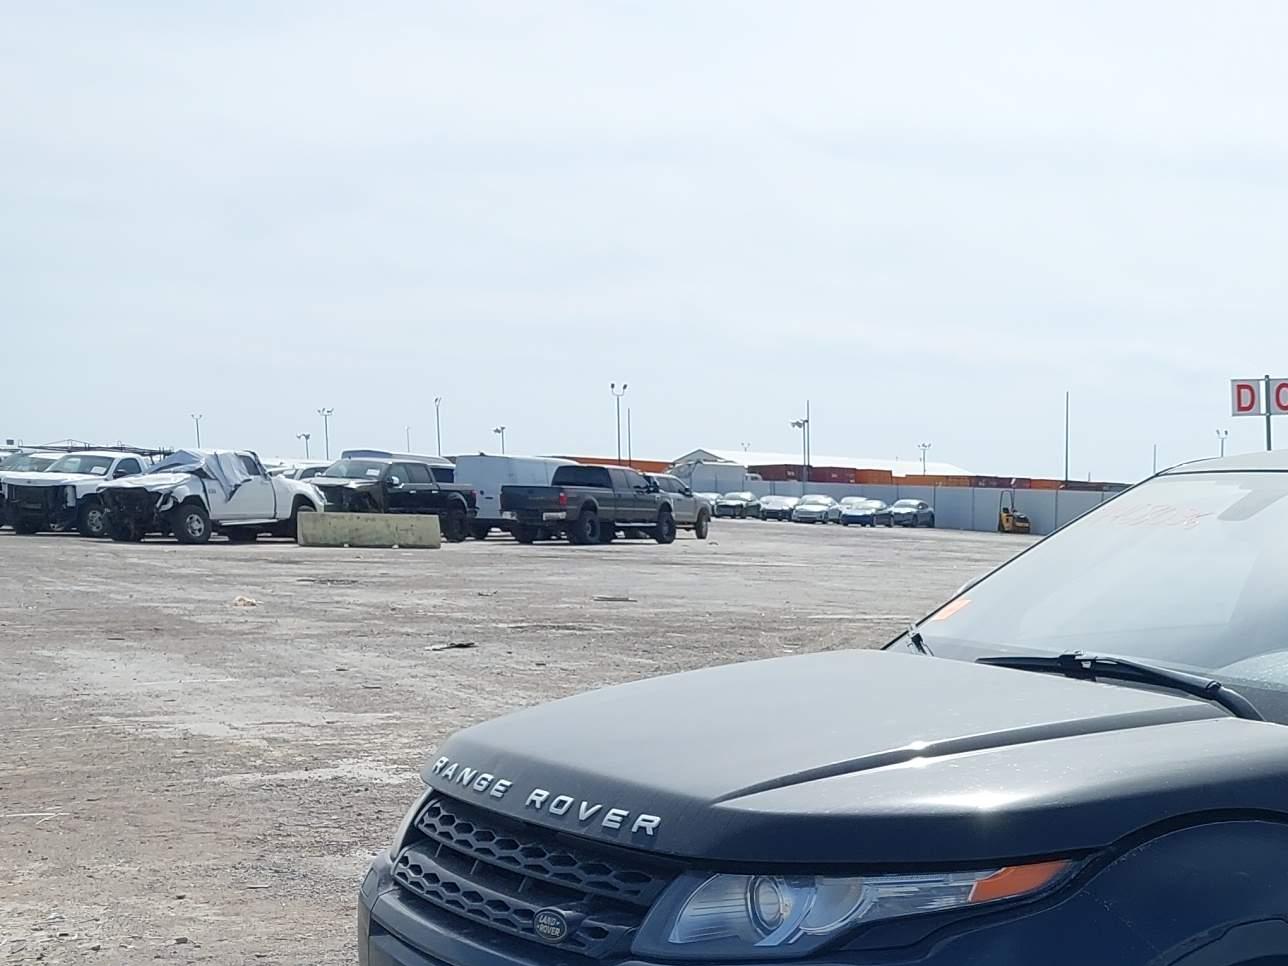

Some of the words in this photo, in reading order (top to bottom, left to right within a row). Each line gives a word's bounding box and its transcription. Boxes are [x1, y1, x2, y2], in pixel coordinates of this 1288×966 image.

[1236, 384, 1256, 412] D
[432, 756, 512, 798] RANGE
[525, 788, 661, 836] ROVER
[539, 914, 557, 926] LAND
[539, 923, 560, 937] ROVER
